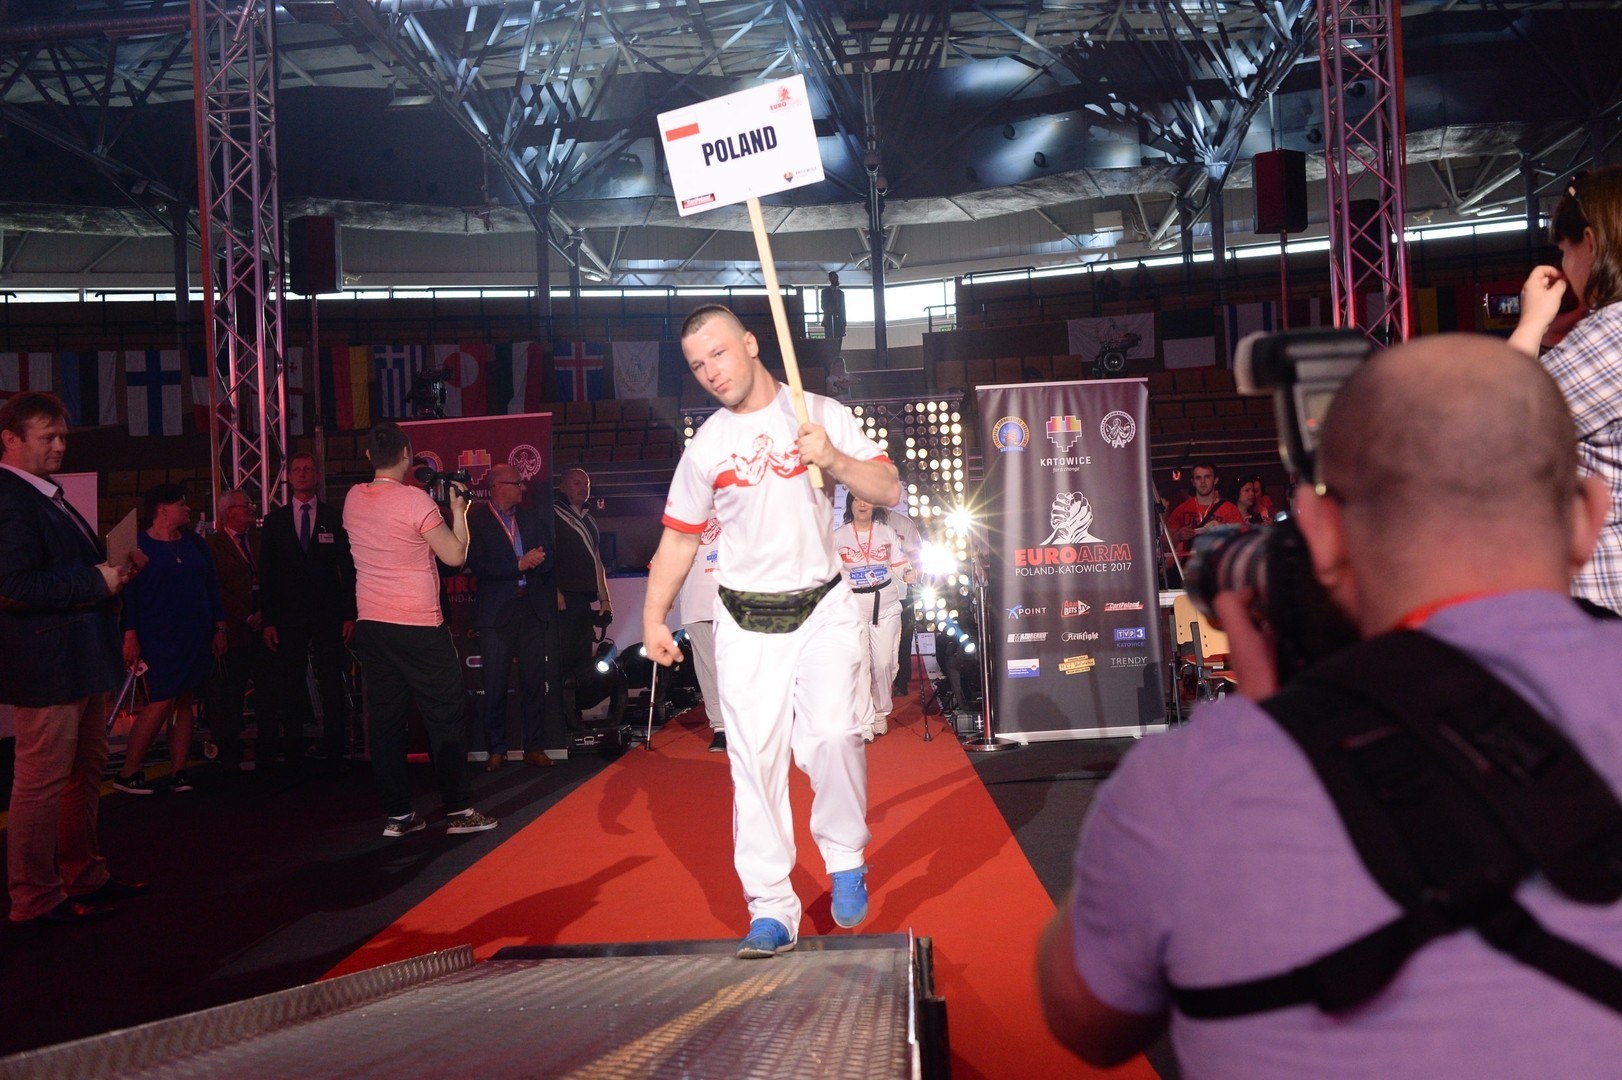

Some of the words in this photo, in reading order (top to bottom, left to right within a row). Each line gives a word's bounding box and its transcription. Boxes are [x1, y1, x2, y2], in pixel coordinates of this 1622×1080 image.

[702, 125, 778, 167] POLAND
[1040, 456, 1091, 467] KATOWICE
[1014, 544, 1132, 566] EUROARM
[1015, 564, 1107, 577] POLAND-KATOWICE
[1110, 562, 1132, 572] 2017
[1110, 656, 1148, 665] TRENDY
